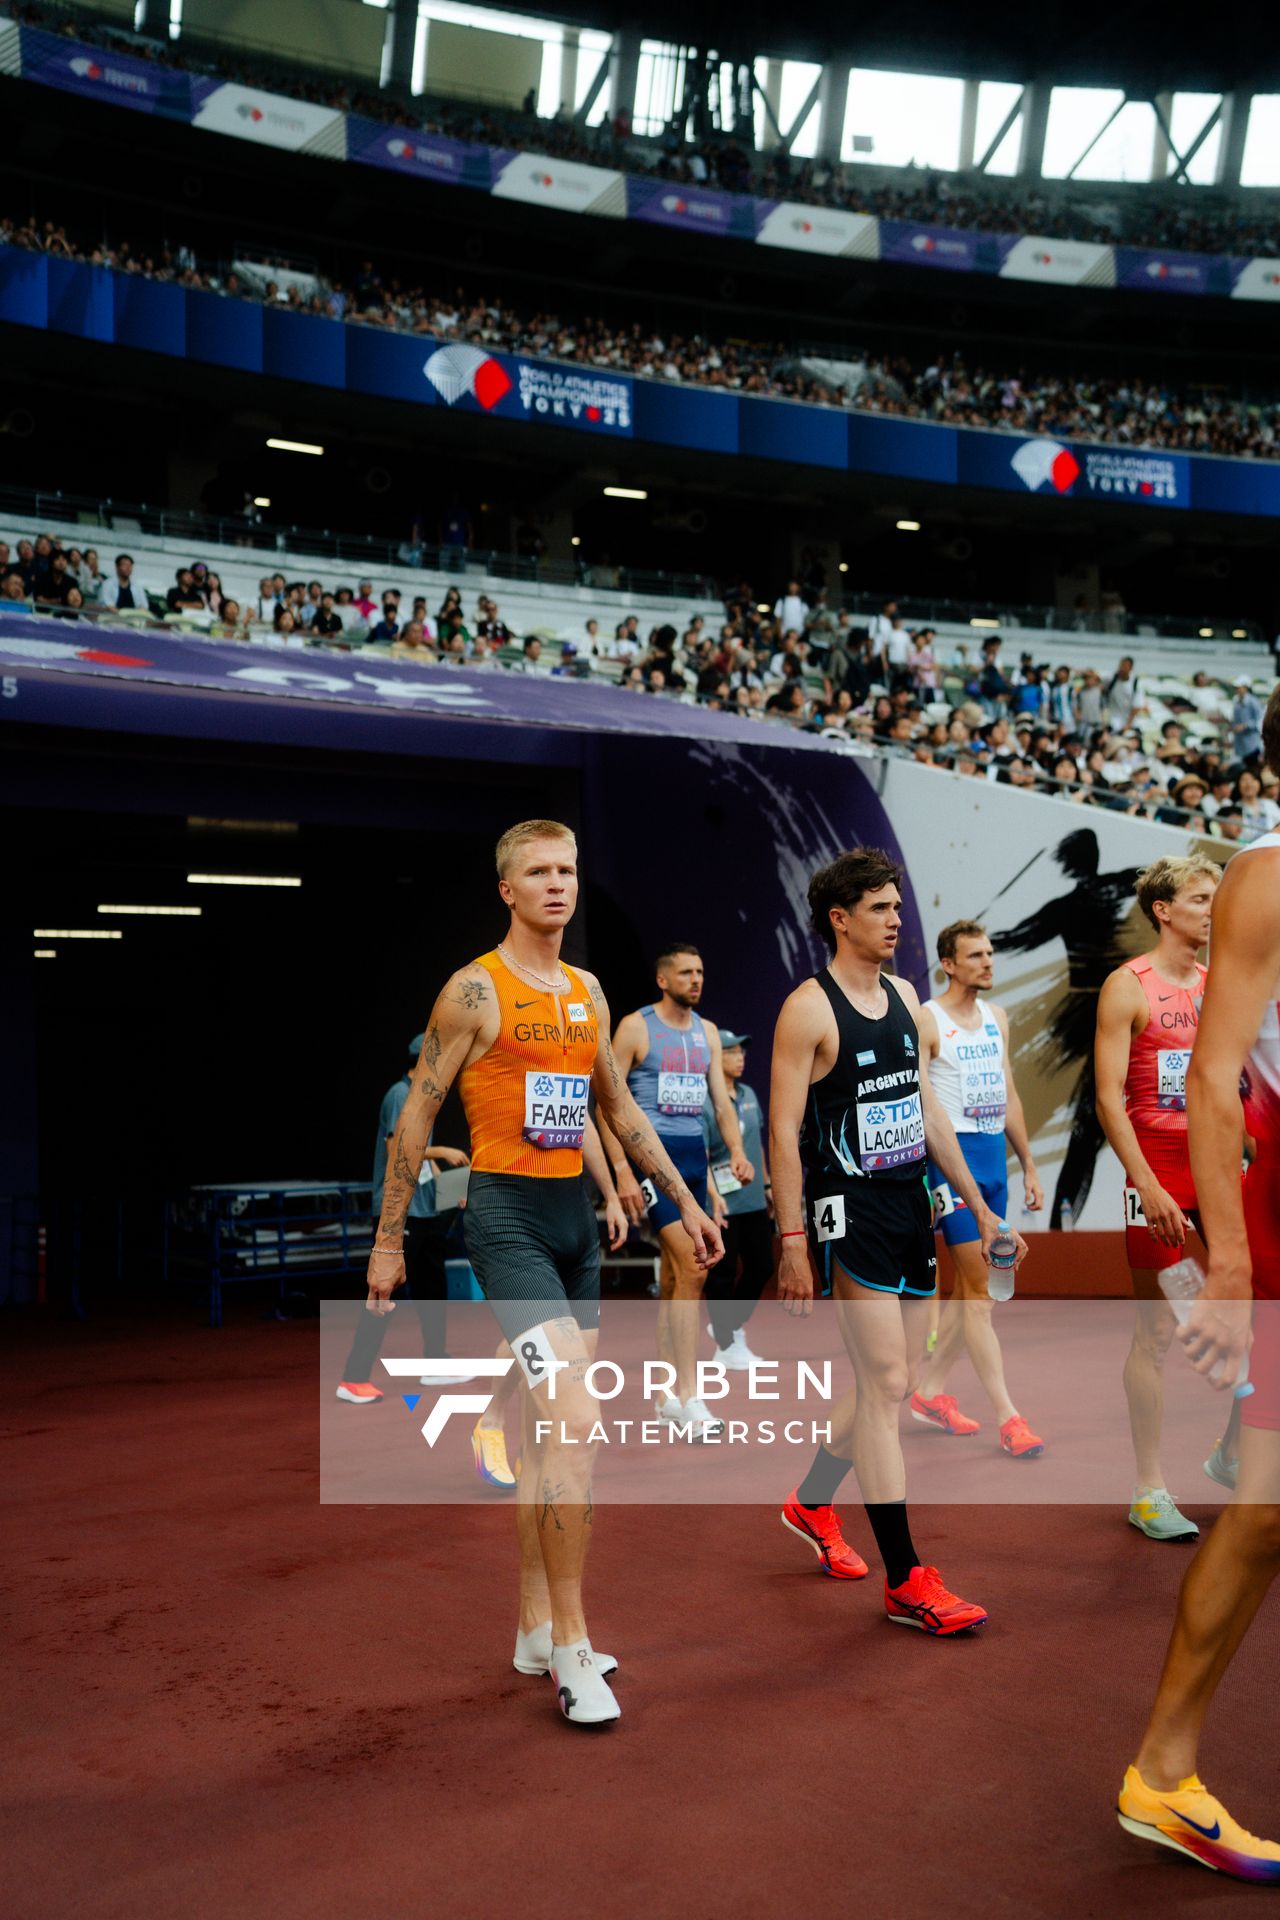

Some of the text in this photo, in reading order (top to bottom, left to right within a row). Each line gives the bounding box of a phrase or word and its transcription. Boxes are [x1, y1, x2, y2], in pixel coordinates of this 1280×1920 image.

[956, 1042, 999, 1060] CZECHIA
[554, 1076, 588, 1098] TD
[676, 1075, 704, 1087] TDK
[979, 1071, 1004, 1086] TDK
[532, 1103, 586, 1127] FARKE
[885, 1096, 919, 1123] TDK
[820, 1204, 836, 1233] 4
[1129, 1194, 1144, 1220] 1
[521, 1341, 545, 1376] 8
